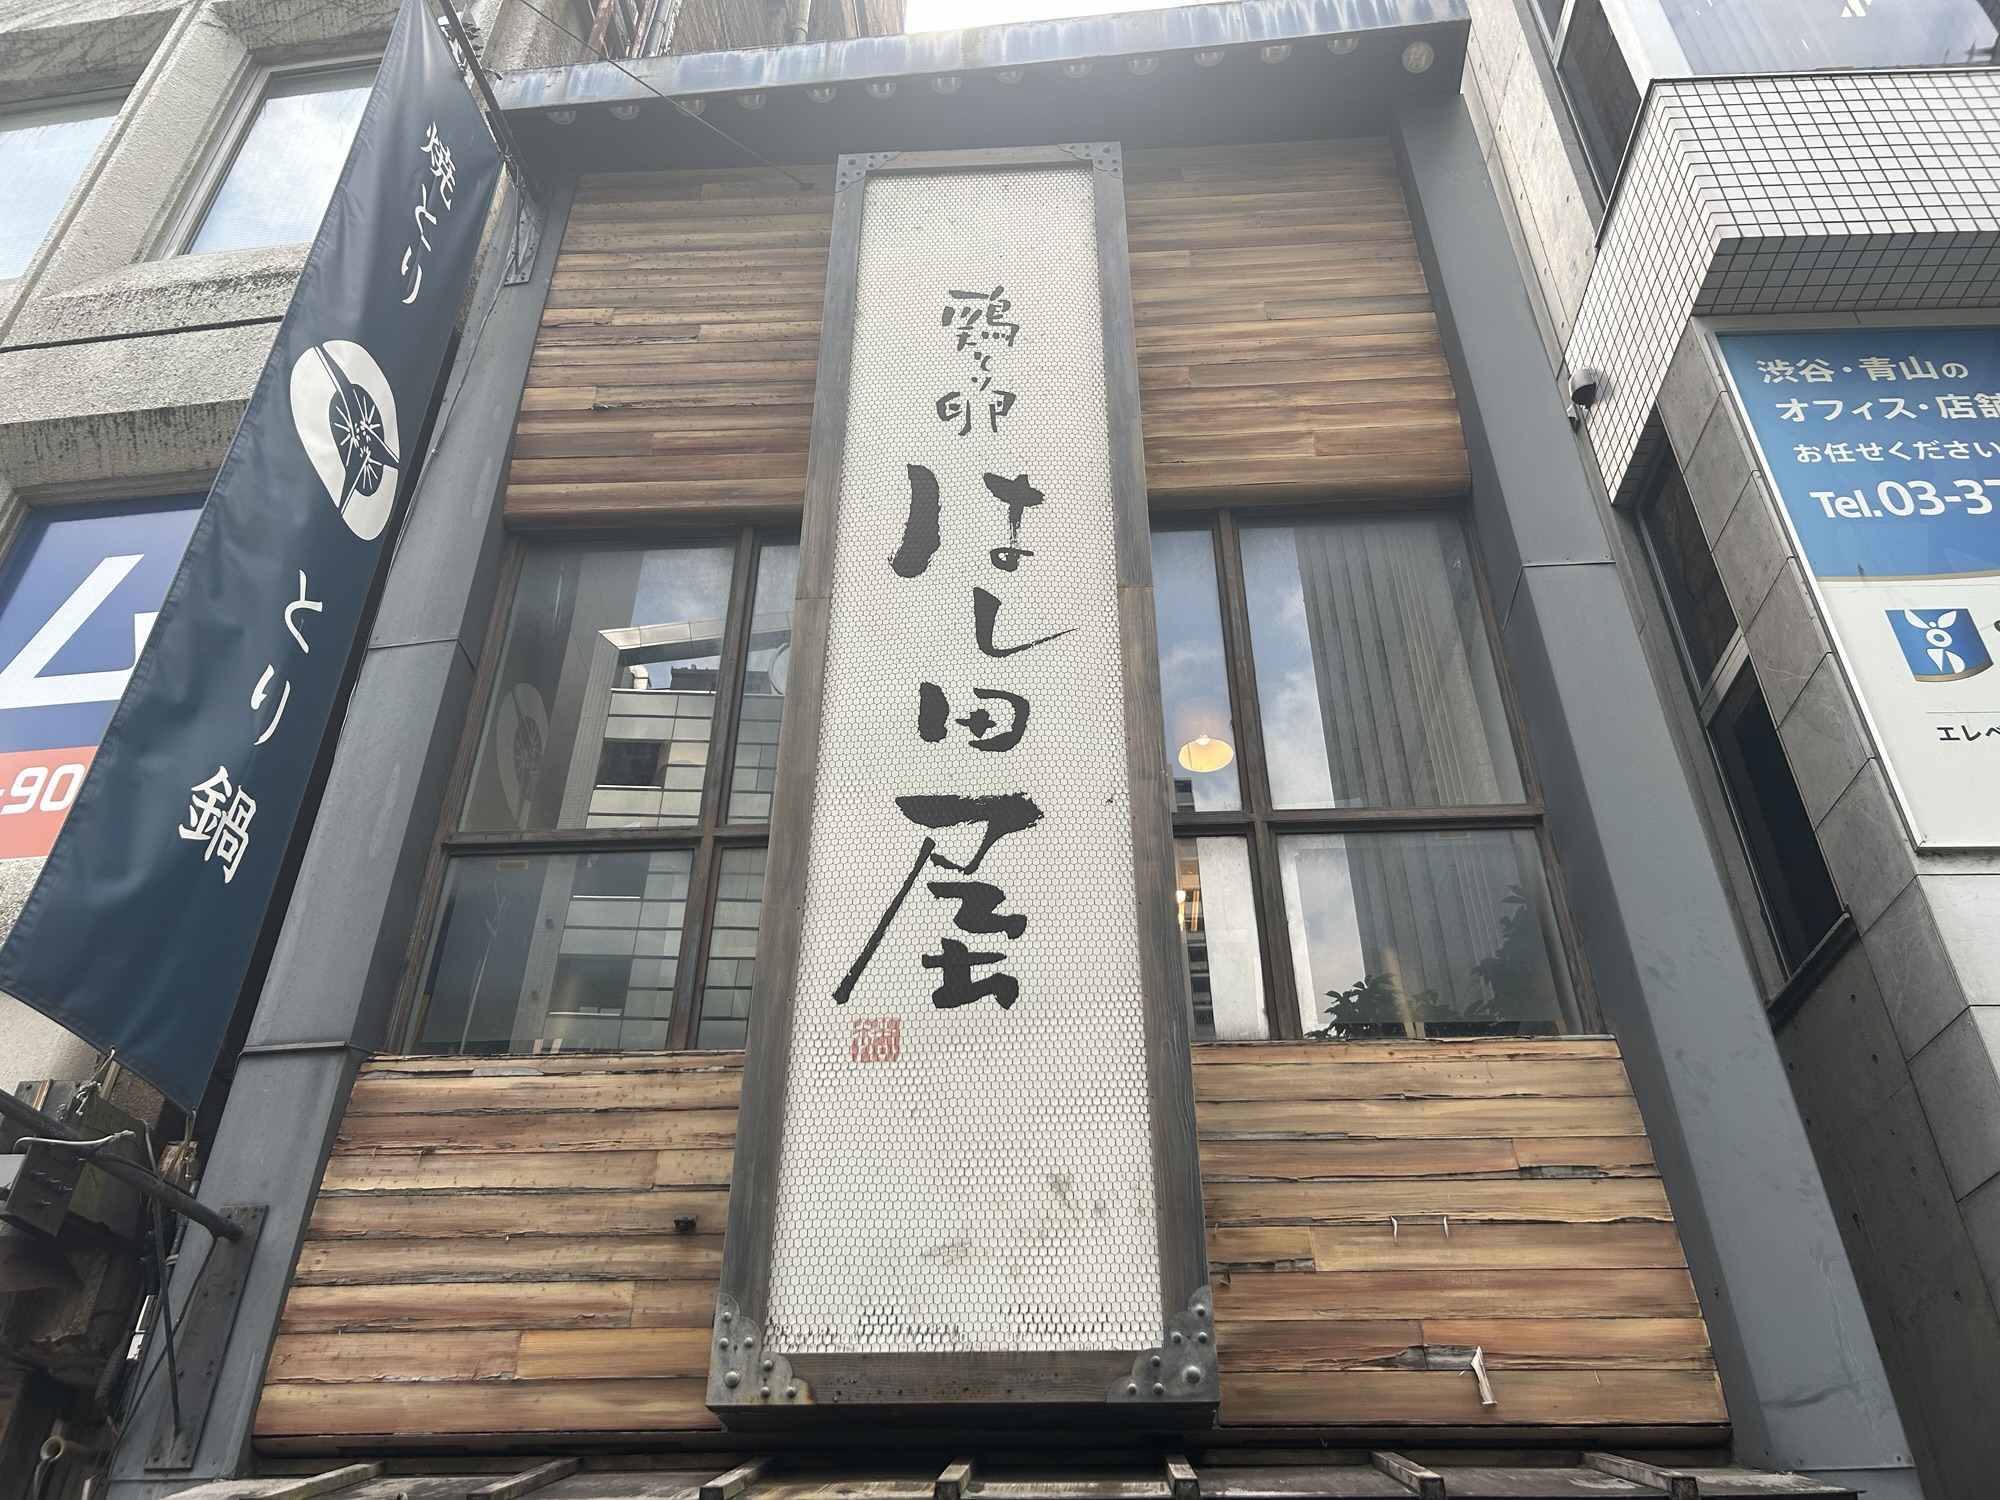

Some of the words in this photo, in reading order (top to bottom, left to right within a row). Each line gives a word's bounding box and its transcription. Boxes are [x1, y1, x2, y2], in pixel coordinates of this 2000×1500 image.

[401, 121, 456, 304] 焼とり
[1756, 356, 1969, 384] 渋谷・青山の
[1793, 440, 2000, 463] お任せください
[178, 569, 323, 884] とり鍋
[832, 463, 1078, 1010] はし田屋
